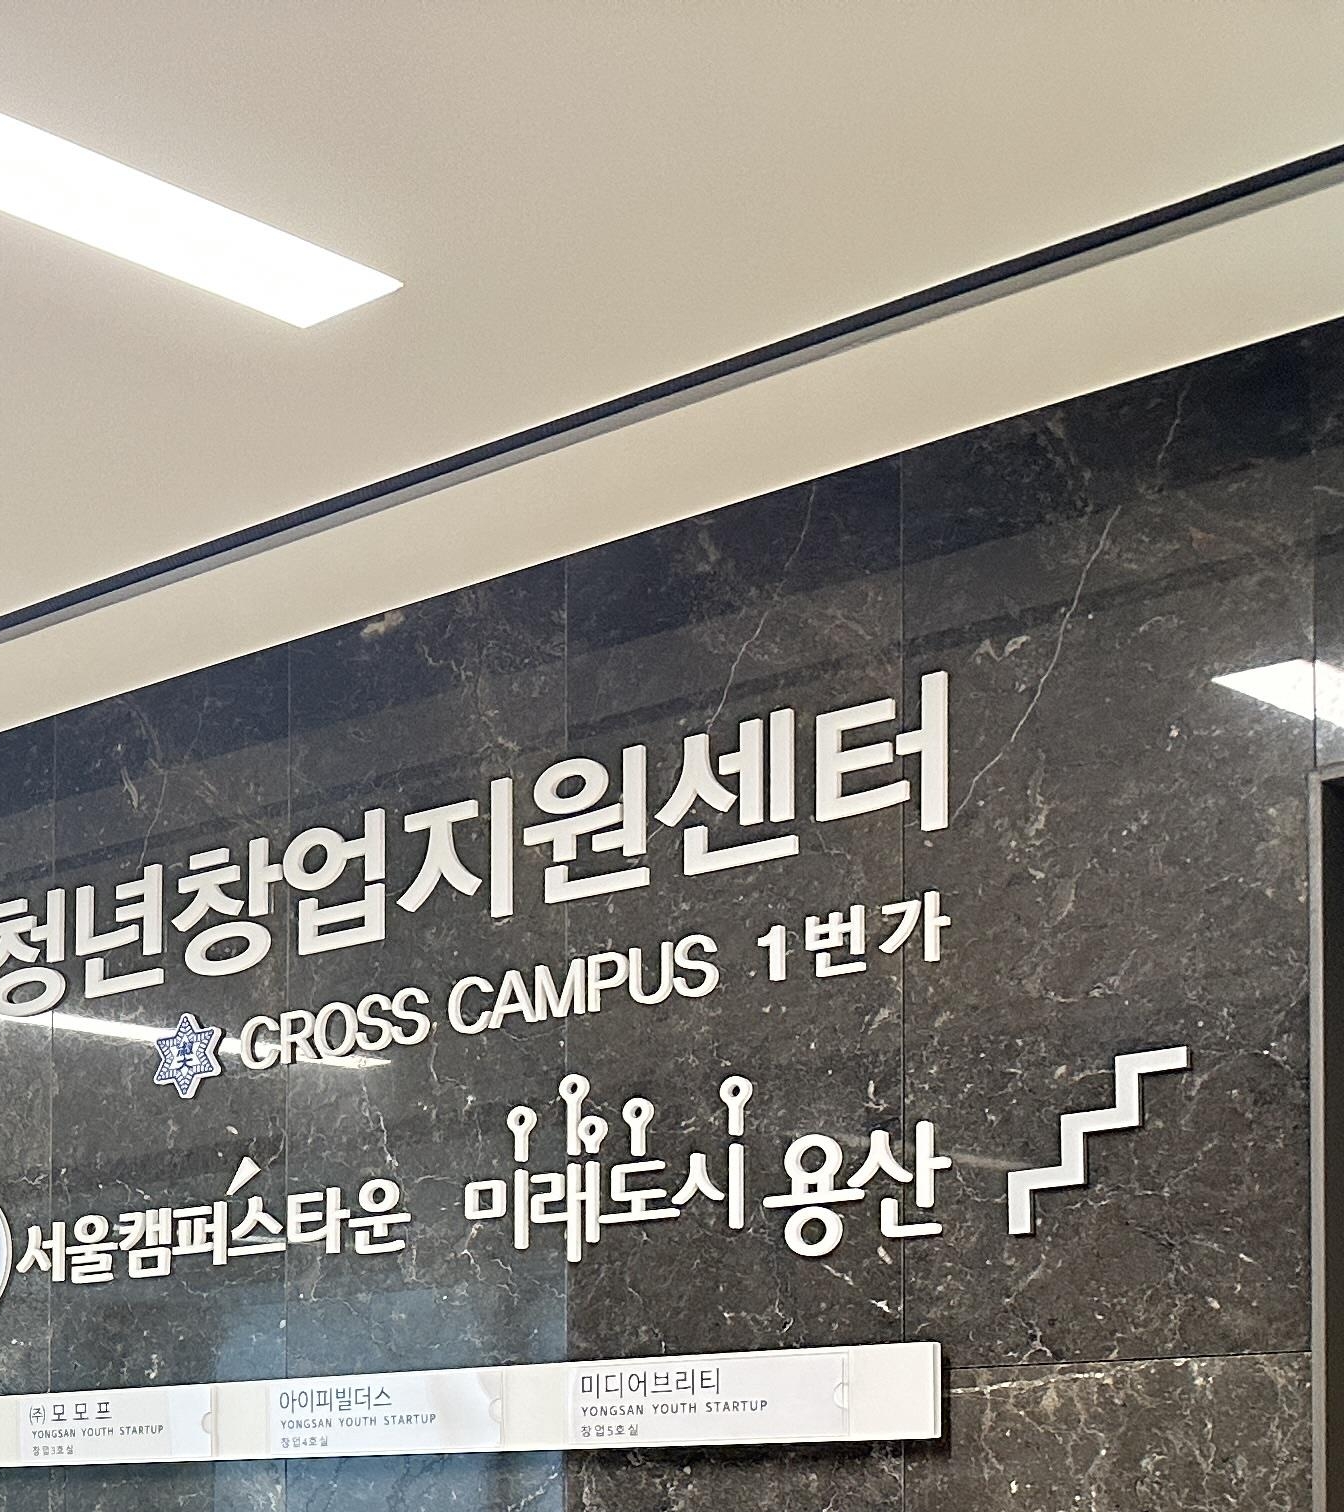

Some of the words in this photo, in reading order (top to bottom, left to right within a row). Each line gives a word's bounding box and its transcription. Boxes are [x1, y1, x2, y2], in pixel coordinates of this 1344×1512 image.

[240, 987, 430, 1071] CROSS
[448, 935, 719, 1035] CAMPUS
[757, 891, 952, 983] 1번가
[464, 1074, 753, 1262] 미래도시
[763, 1120, 952, 1258] 용산
[15, 1156, 411, 1285] 서울캠퍼스타운
[581, 1367, 720, 1400] 미디어브리티
[279, 1386, 393, 1414] 아이피빌더스
[580, 1404, 644, 1417] YONGSAN
[651, 1402, 697, 1415] YOUTH
[705, 1399, 768, 1413] STARTUP
[31, 1428, 76, 1439] YONGSAN
[80, 1426, 114, 1437] YOUTH
[119, 1424, 164, 1436] STARTUP
[280, 1418, 333, 1430] YONGSAN
[338, 1416, 377, 1428] YOUTH
[383, 1413, 437, 1426] STARTUP
[580, 1423, 639, 1438] 창업5호실
